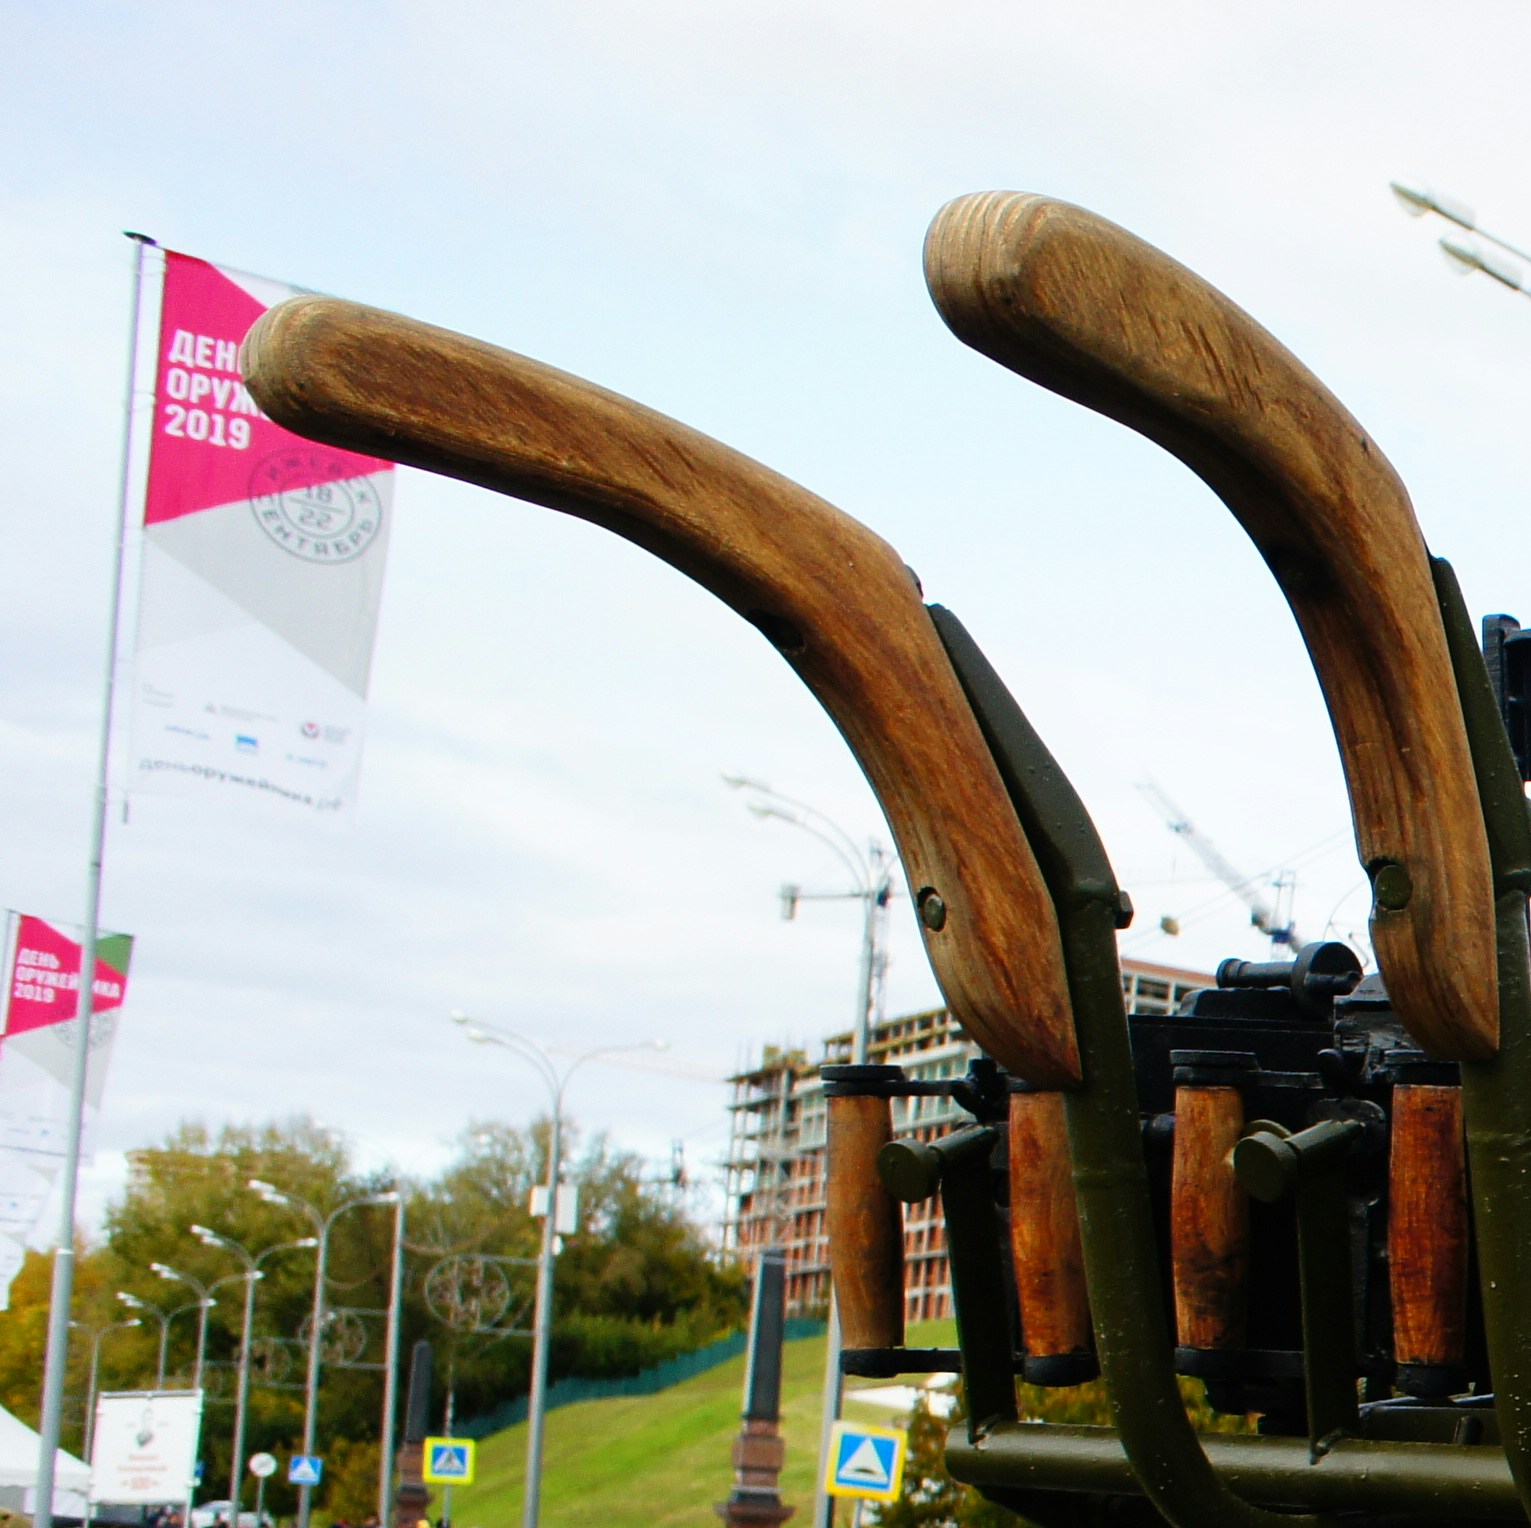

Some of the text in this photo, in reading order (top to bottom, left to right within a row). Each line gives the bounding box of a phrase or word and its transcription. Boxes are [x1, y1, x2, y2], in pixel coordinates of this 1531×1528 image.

[168, 328, 241, 374] ДЕН
[166, 367, 272, 422] ОРУЖ
[164, 403, 252, 450] 2019
[17, 947, 61, 970] ДЕНЬ
[13, 982, 56, 1004] 2019
[15, 965, 121, 998] ОРУЖЕЙИКА
